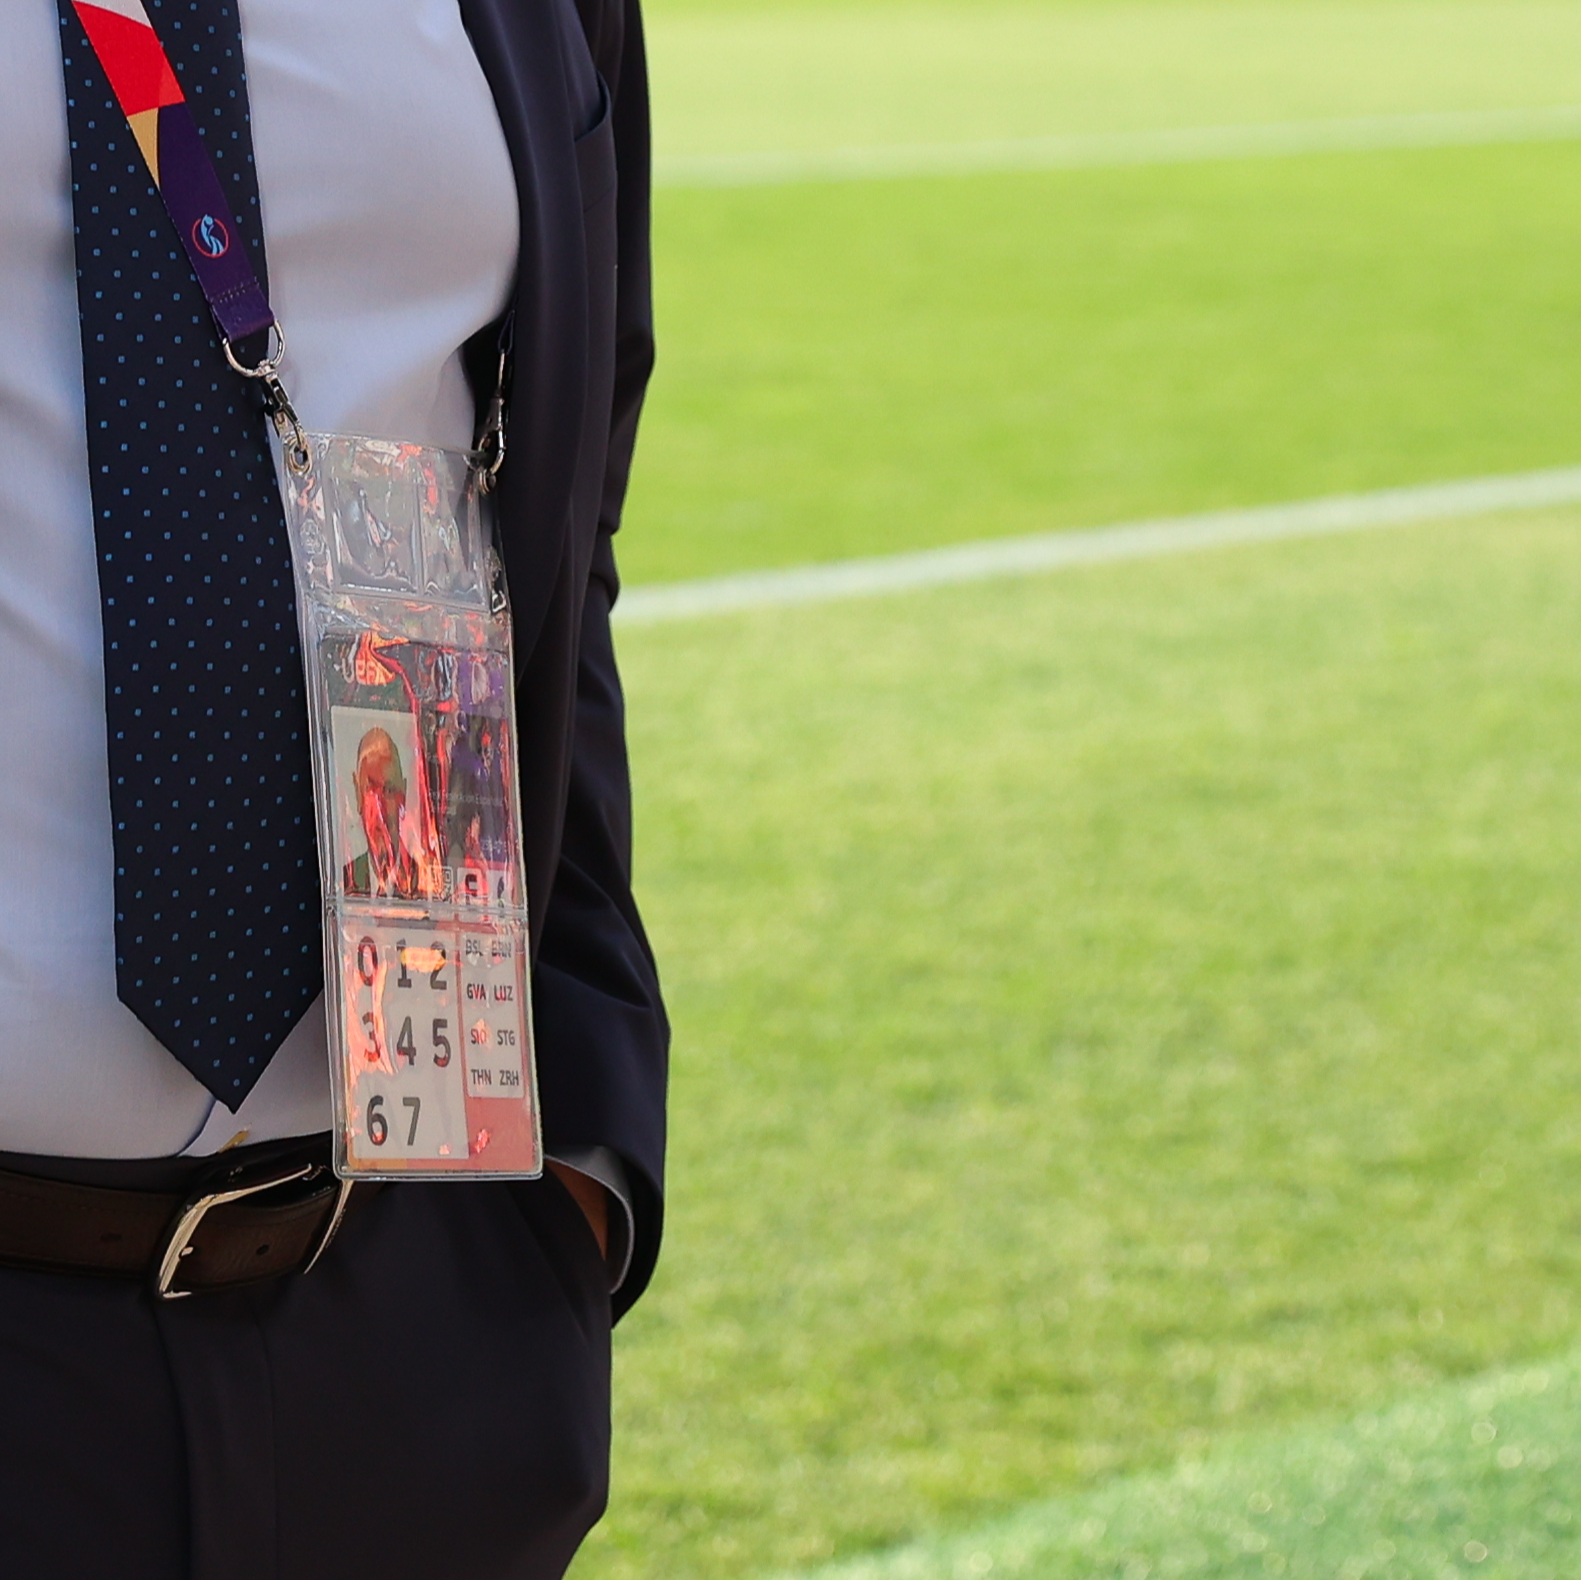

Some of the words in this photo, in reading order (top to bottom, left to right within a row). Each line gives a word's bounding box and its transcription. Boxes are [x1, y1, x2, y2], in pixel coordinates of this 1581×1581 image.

[357, 935, 378, 987] 0
[396, 938, 412, 988] 1
[430, 941, 447, 990] 2
[466, 983, 487, 1001] GVA
[493, 984, 514, 1002] LUZ
[361, 1011, 381, 1063] 3
[396, 1015, 417, 1066] 4
[432, 1018, 452, 1068] 5
[470, 1028, 488, 1045] SIO
[496, 1029, 516, 1046] STG
[470, 1068, 492, 1086] THN
[499, 1069, 520, 1087] ZRH
[366, 1094, 389, 1147] 6
[402, 1096, 421, 1147] 7
